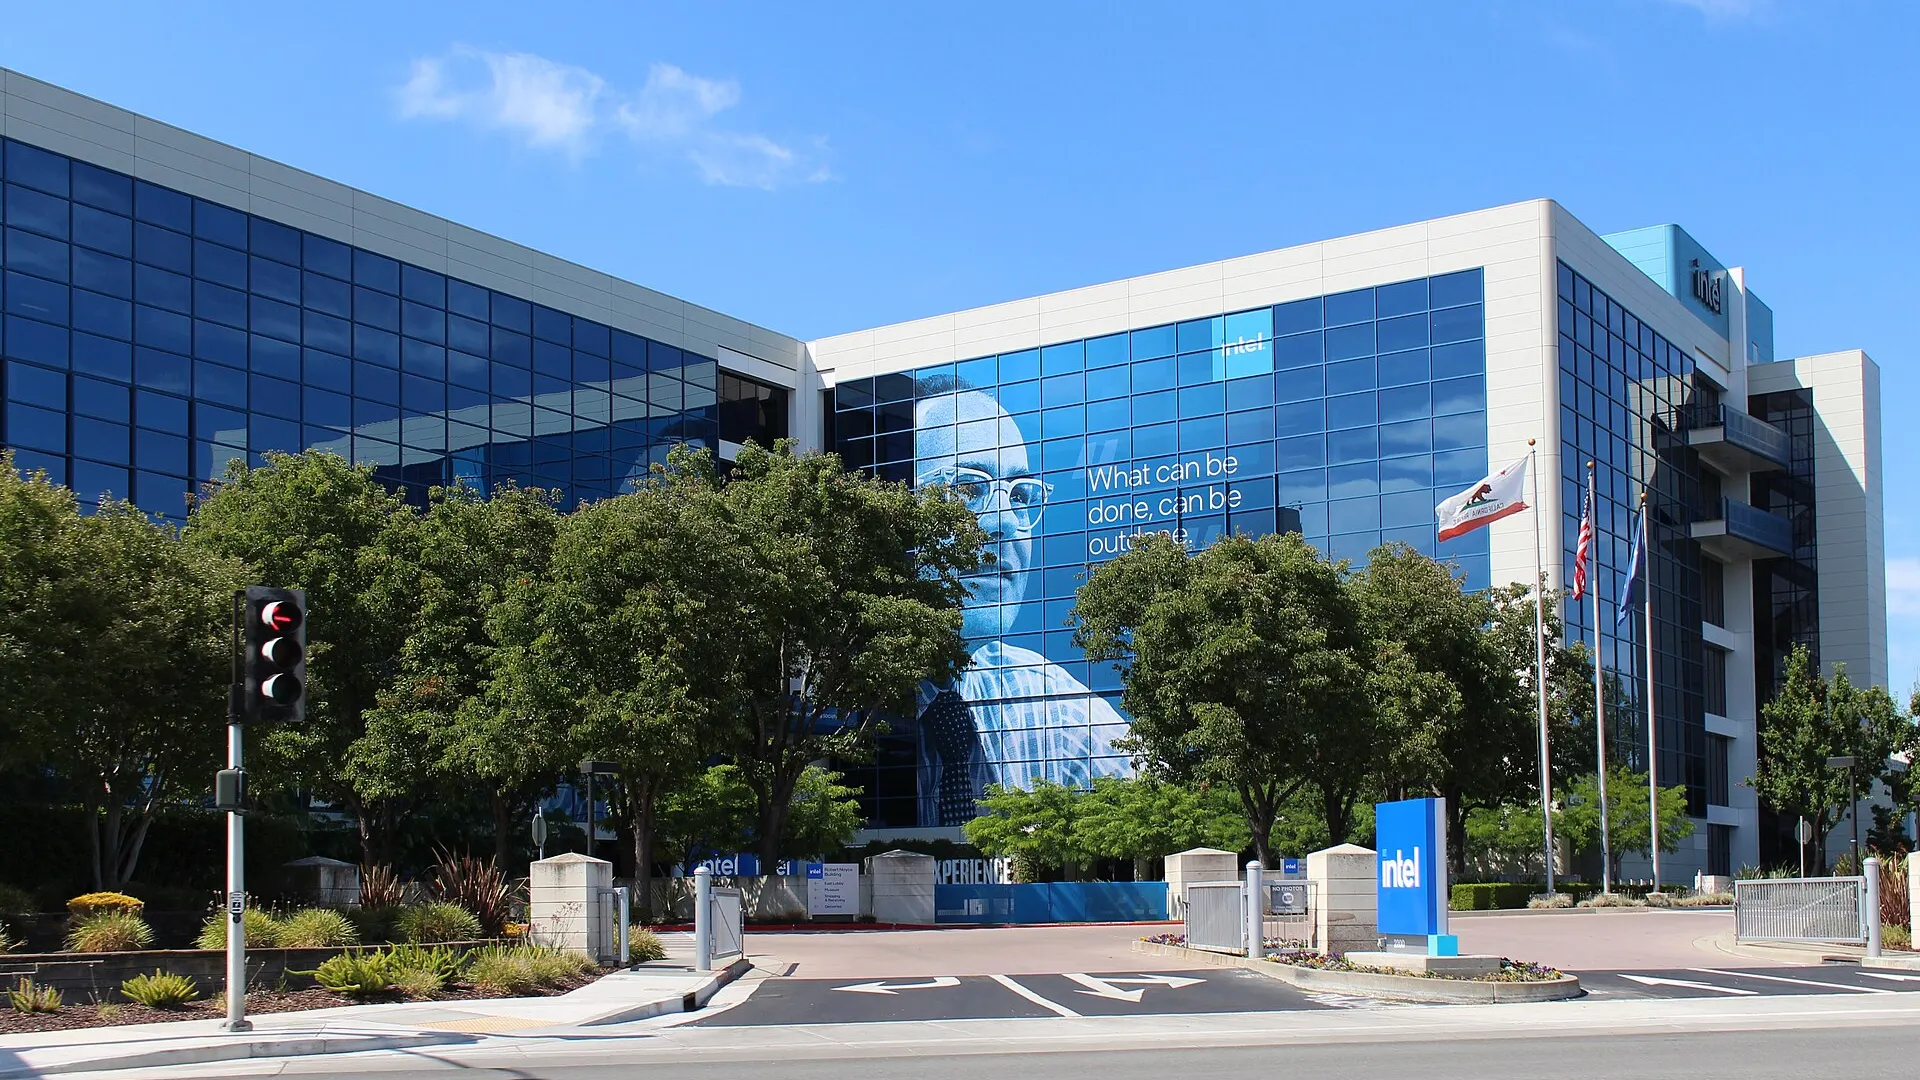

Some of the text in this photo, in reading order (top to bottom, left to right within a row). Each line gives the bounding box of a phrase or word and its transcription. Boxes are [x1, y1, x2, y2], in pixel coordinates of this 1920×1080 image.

[1689, 258, 1721, 315] intel
[1088, 452, 1238, 492] What can be
[1088, 486, 1242, 525] done, can be
[1382, 846, 1420, 888] intel
